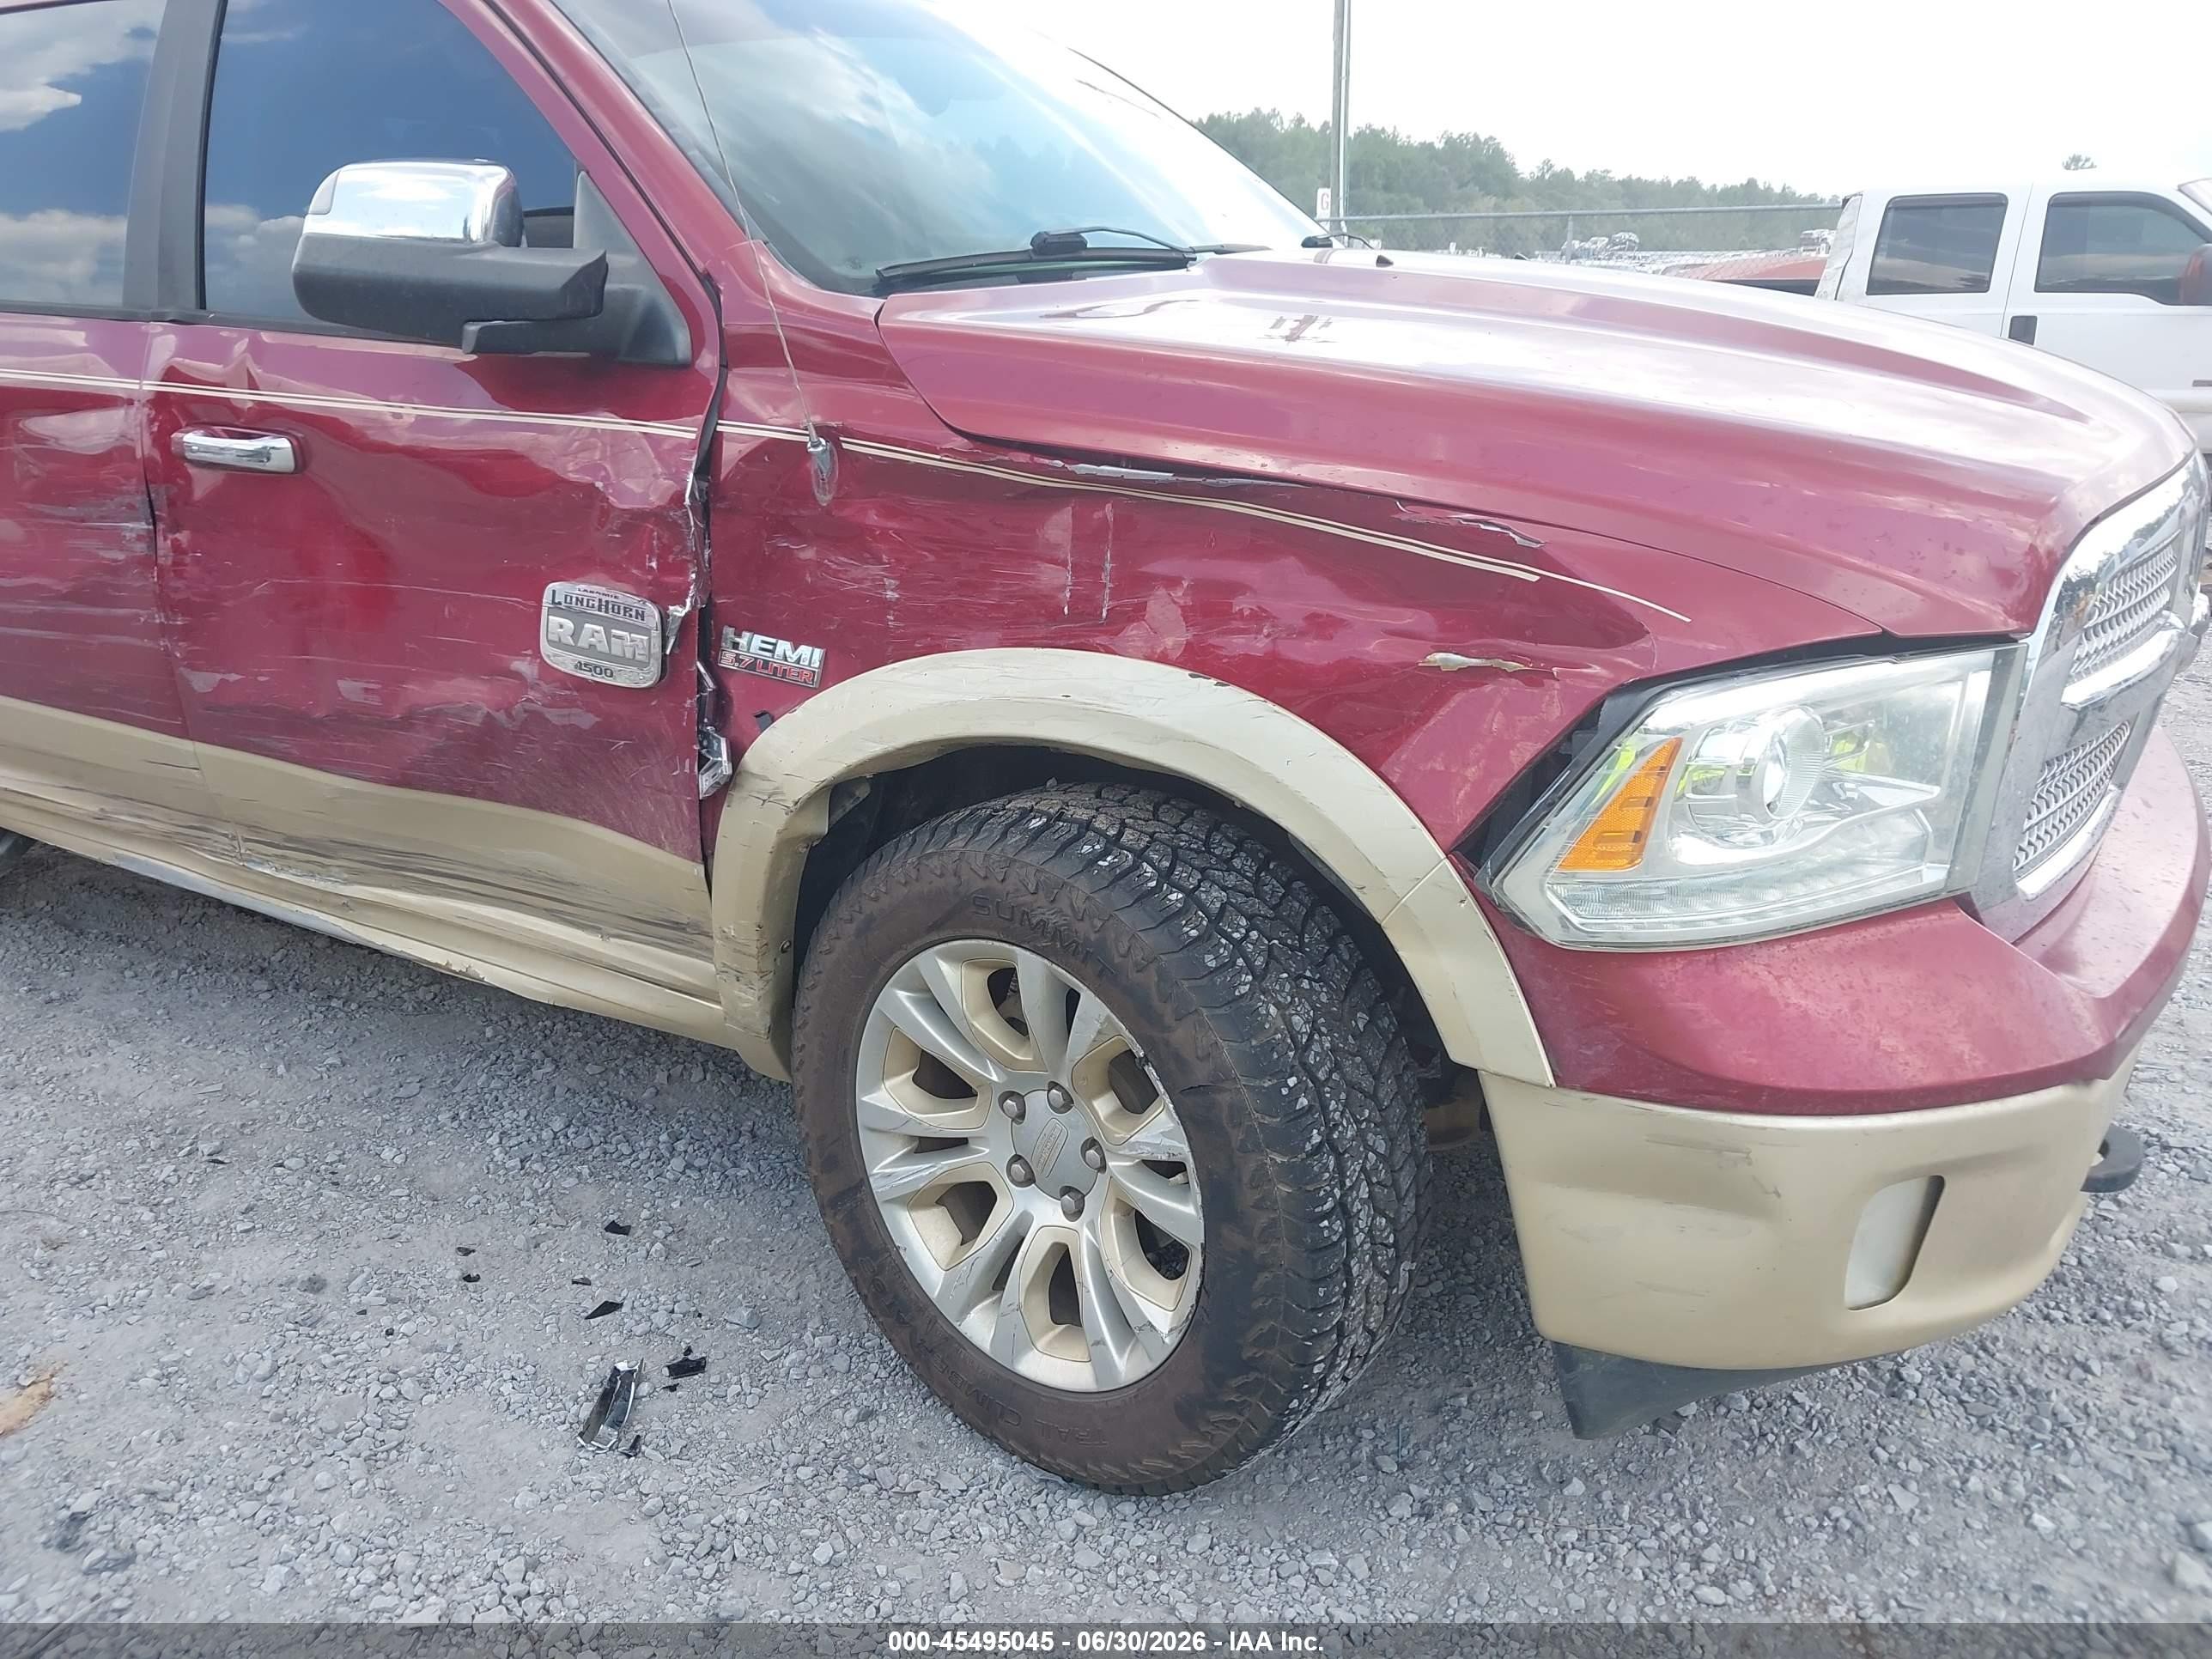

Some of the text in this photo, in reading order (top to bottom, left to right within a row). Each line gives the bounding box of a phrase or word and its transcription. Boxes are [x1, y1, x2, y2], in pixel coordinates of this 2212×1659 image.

[547, 615, 650, 662] RAM
[721, 625, 825, 667] HEMI
[720, 651, 814, 684] 5.7 LITER
